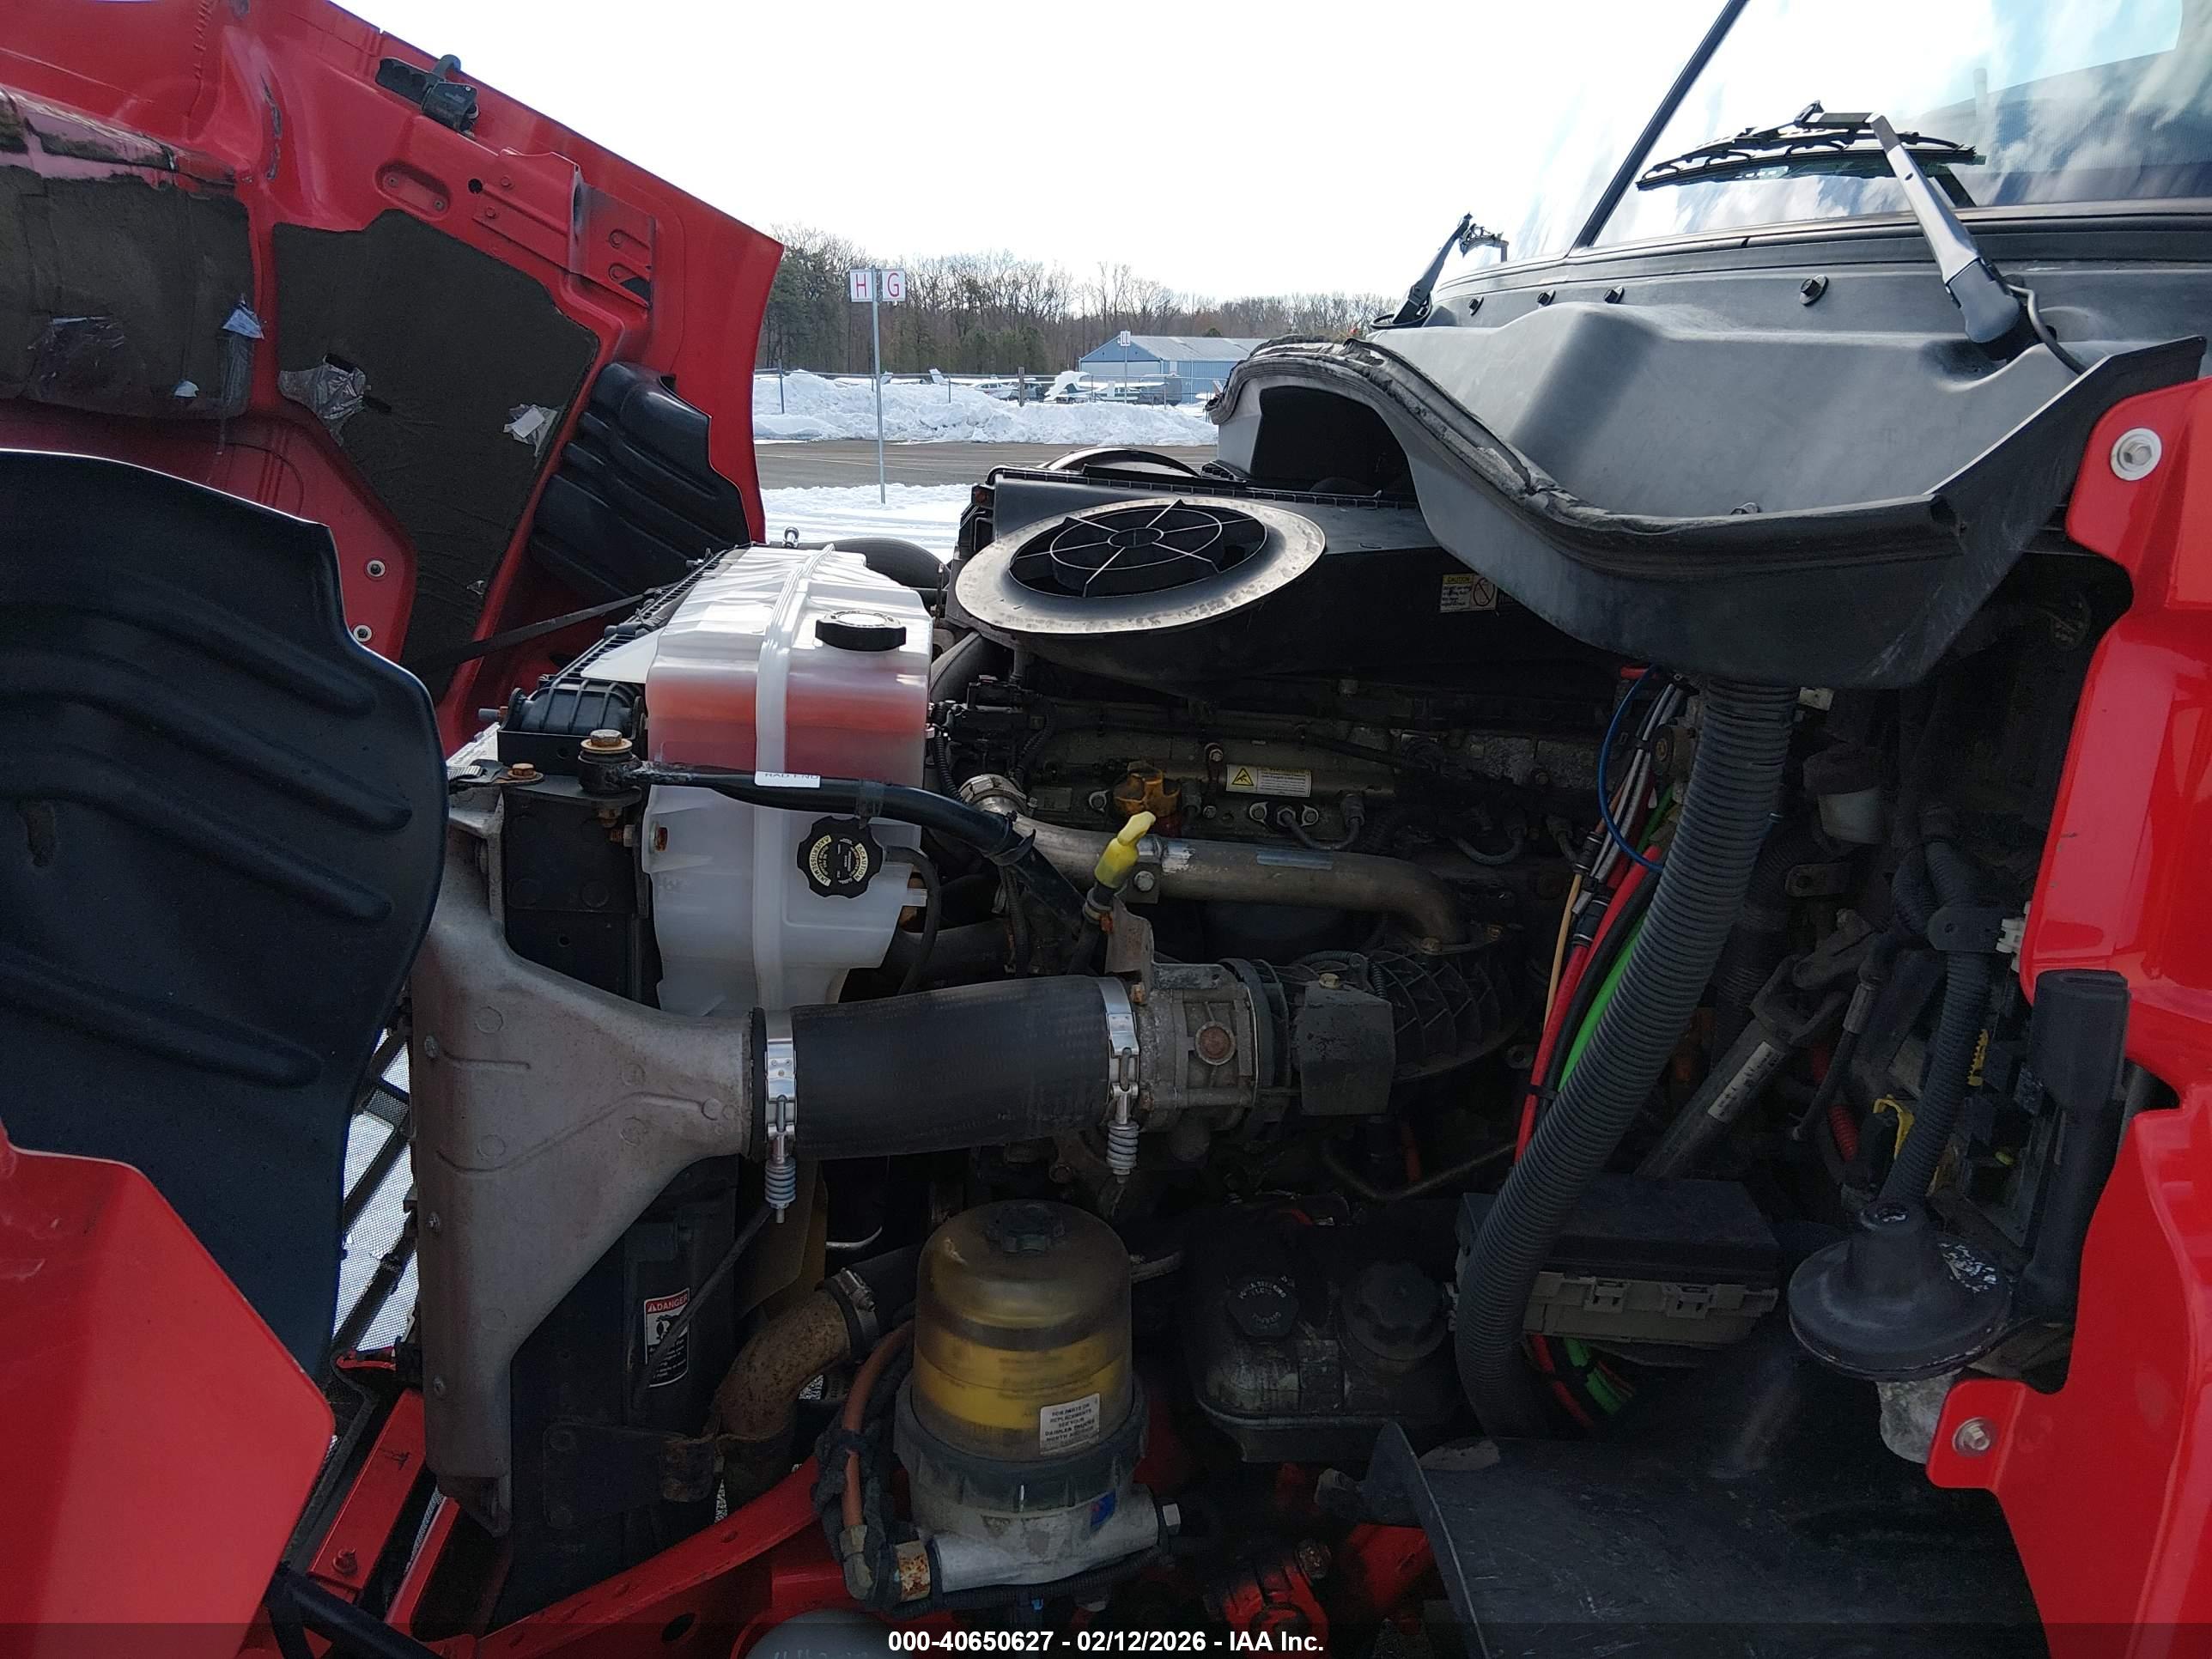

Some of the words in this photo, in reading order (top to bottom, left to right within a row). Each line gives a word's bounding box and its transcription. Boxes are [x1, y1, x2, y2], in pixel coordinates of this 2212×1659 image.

[855, 273, 867, 298] H
[887, 272, 900, 298] G
[811, 840, 828, 884] AVERTISSEMENT
[854, 850, 867, 881] CAUTION
[657, 1294, 688, 1311] DANGER
[1064, 1406, 1082, 1414] PARTS
[1044, 1427, 1073, 1437] DAIMLER
